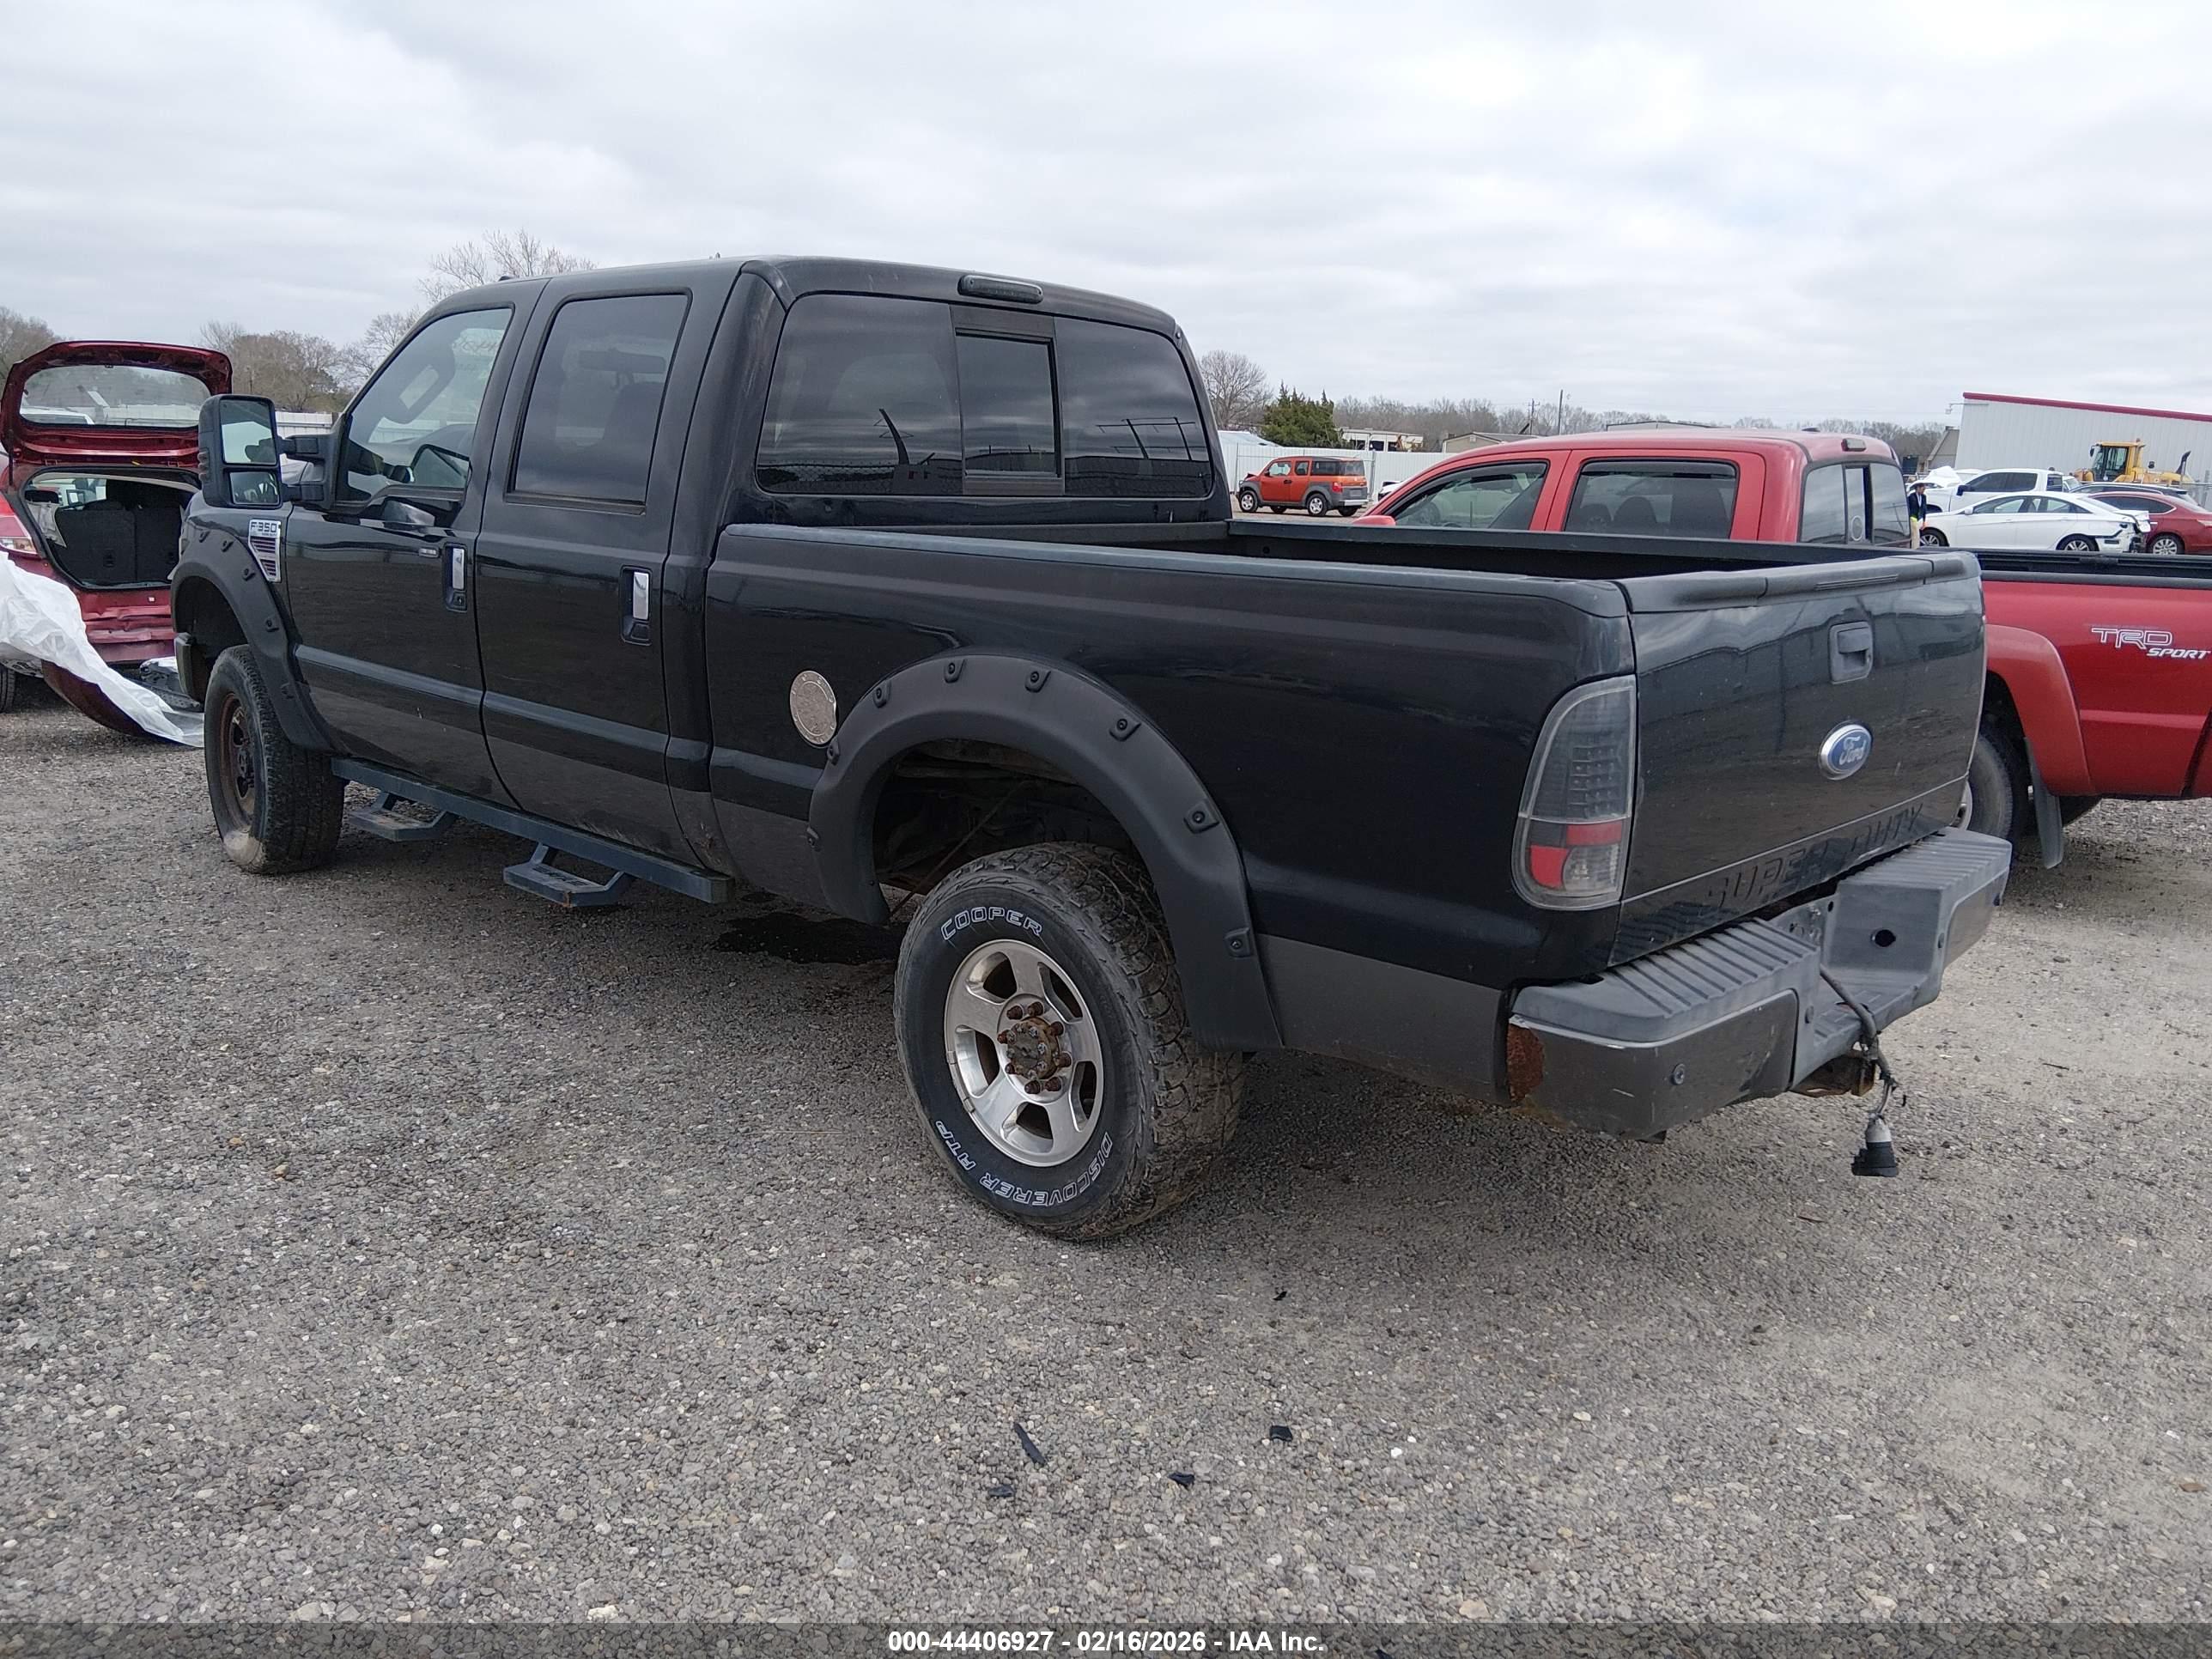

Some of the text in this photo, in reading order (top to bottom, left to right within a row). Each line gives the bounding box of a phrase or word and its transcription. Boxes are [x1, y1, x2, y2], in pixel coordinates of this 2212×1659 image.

[2091, 627, 2173, 650] TRD
[2146, 647, 2211, 659] SPORT
[1838, 735, 1867, 766] Ford
[941, 906, 1043, 942] COOPER
[935, 1120, 1114, 1207] DISCOVERER ATP
